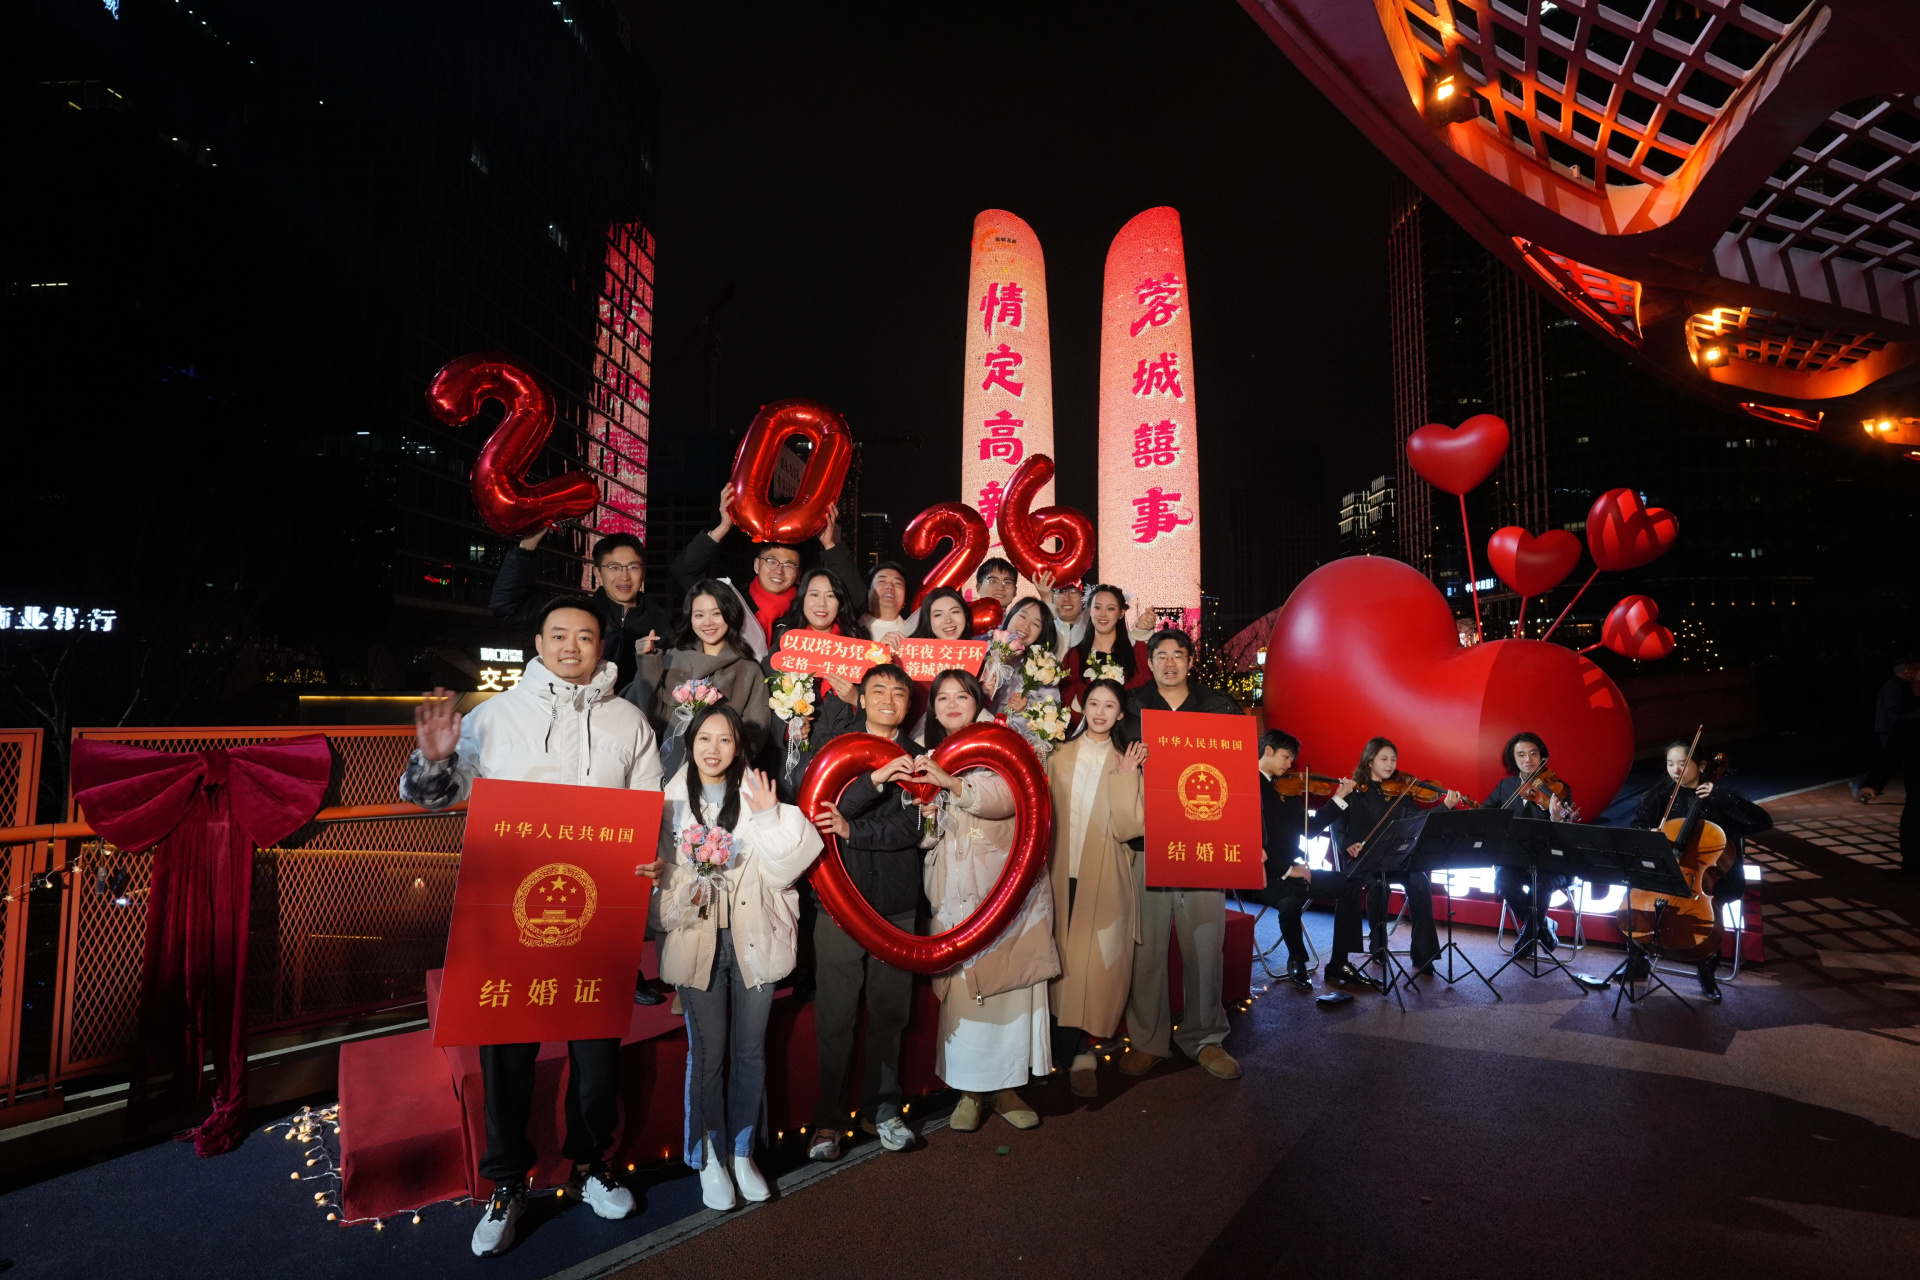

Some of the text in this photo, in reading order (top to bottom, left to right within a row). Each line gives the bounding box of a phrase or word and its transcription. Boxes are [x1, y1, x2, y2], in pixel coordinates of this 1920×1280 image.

[1130, 272, 1193, 543] 蓉城囍事
[783, 635, 864, 660] 以双塔为凭
[939, 645, 983, 661] 交子环
[477, 667, 523, 691] 交子
[781, 655, 863, 679] 定格一生欢喜
[1158, 735, 1243, 751] 中华人民共和国
[494, 821, 635, 843] 中华人民共和国
[1167, 841, 1242, 863] 结婚证
[479, 977, 603, 1008] 结婚证
